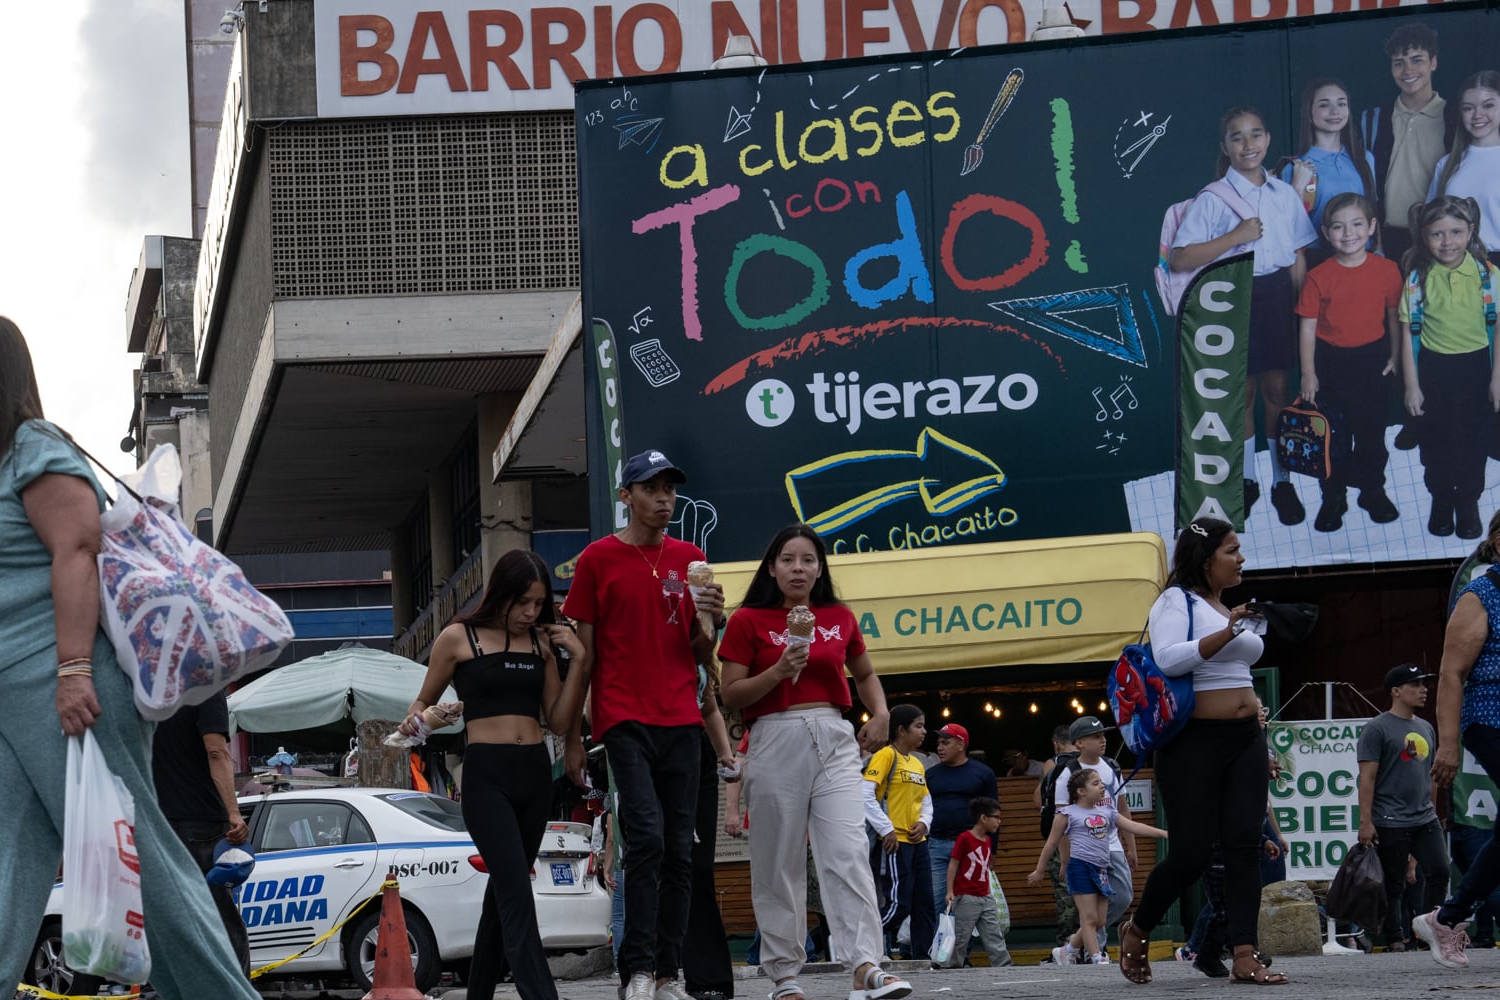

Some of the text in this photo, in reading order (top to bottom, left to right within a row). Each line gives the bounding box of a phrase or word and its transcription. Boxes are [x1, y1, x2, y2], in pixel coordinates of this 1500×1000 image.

[338, 3, 683, 97] BARRIO
[659, 91, 961, 189] a clases
[806, 371, 1039, 435] tijerazo
[1190, 281, 1236, 526] COCADA
[888, 506, 1019, 550] Chacaito
[894, 597, 1083, 637] CHACAITO
[1269, 770, 1360, 798] COC
[389, 860, 460, 878] DSC-007
